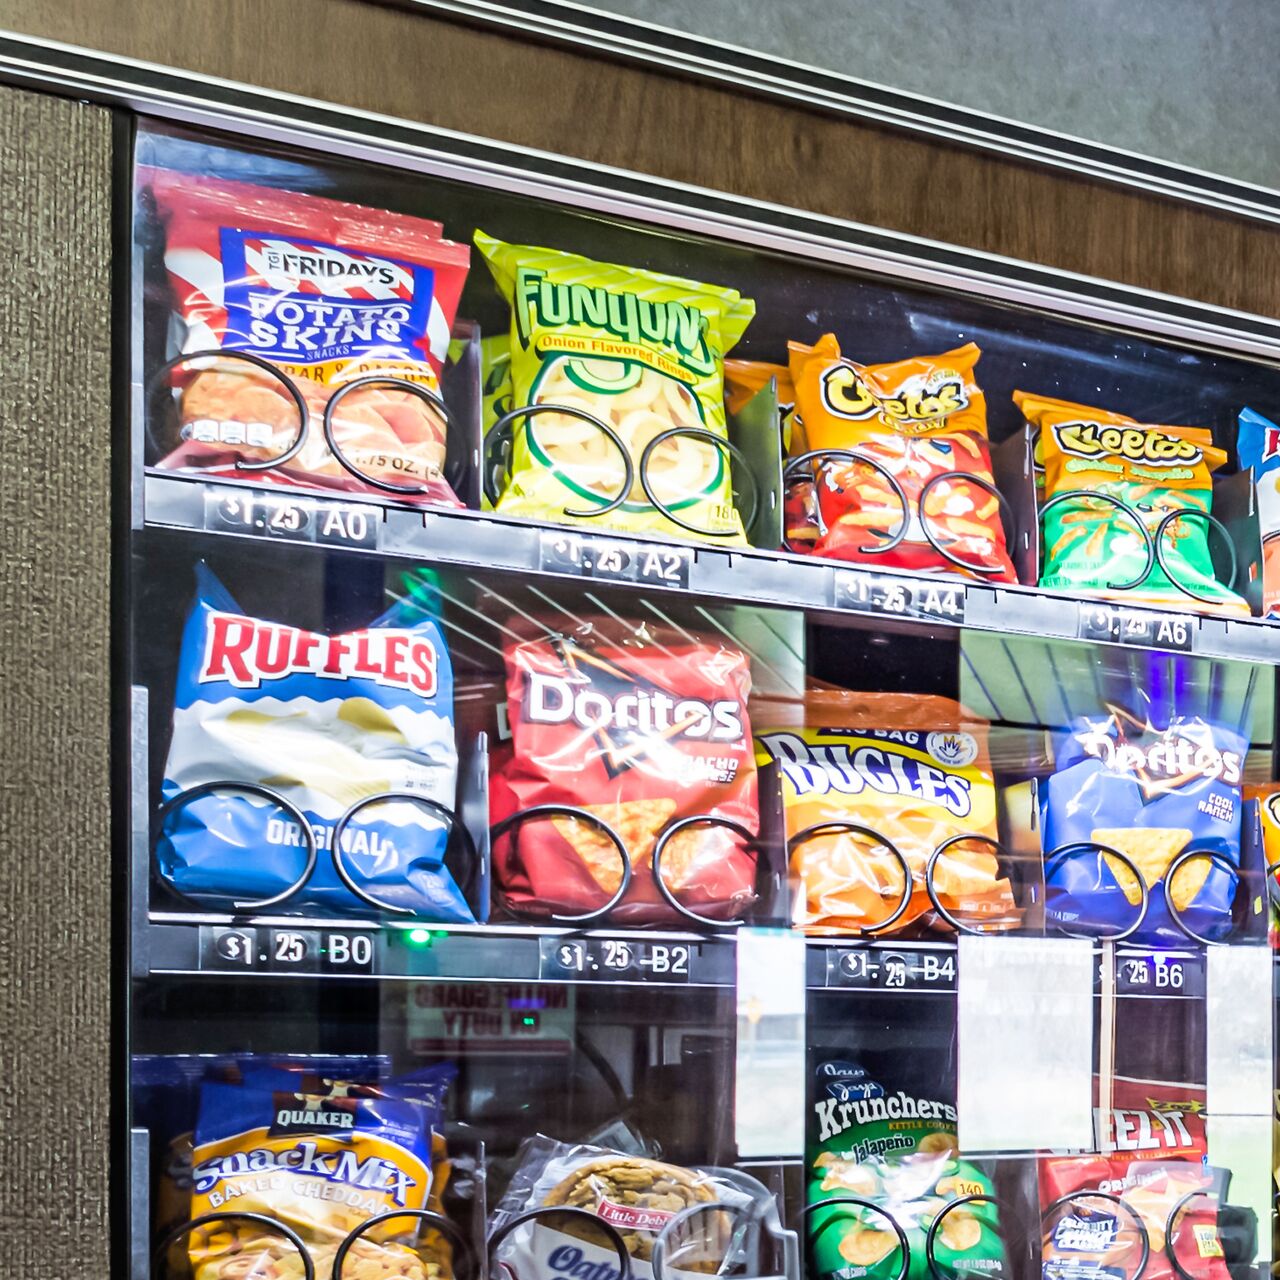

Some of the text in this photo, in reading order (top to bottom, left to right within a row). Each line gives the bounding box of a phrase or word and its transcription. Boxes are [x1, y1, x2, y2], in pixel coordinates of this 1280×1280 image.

[283, 252, 396, 284] FRIDAYS
[249, 296, 410, 326] POTATO
[515, 266, 717, 377] FUNYUNS
[250, 320, 402, 350] SKINS
[306, 344, 351, 361] SNACKS
[542, 336, 694, 381] Onion Flavored Rings
[642, 553, 681, 580] A2
[923, 588, 958, 616] A4
[1157, 620, 1187, 645] A6
[203, 613, 436, 694] RUFFLES
[529, 672, 743, 738] Doritos
[1083, 734, 1241, 783] Doritos
[761, 733, 971, 818] BUGLES
[1198, 801, 1234, 822] RANCH
[1208, 792, 1234, 811] COOL
[266, 818, 384, 858] ORIGINAL
[651, 946, 688, 973] B2
[923, 955, 956, 981] B4
[1155, 963, 1183, 988] B6
[277, 1109, 354, 1129] QUAKER
[814, 1091, 958, 1142] Krunchers
[888, 1120, 923, 1131] KETTLE
[851, 1133, 915, 1165] Jalapeño
[193, 1141, 335, 1193] Snack
[208, 1176, 391, 1216] BAKED CHEDDAR
[960, 1182, 983, 1196] 140
[602, 1206, 635, 1222] Little
